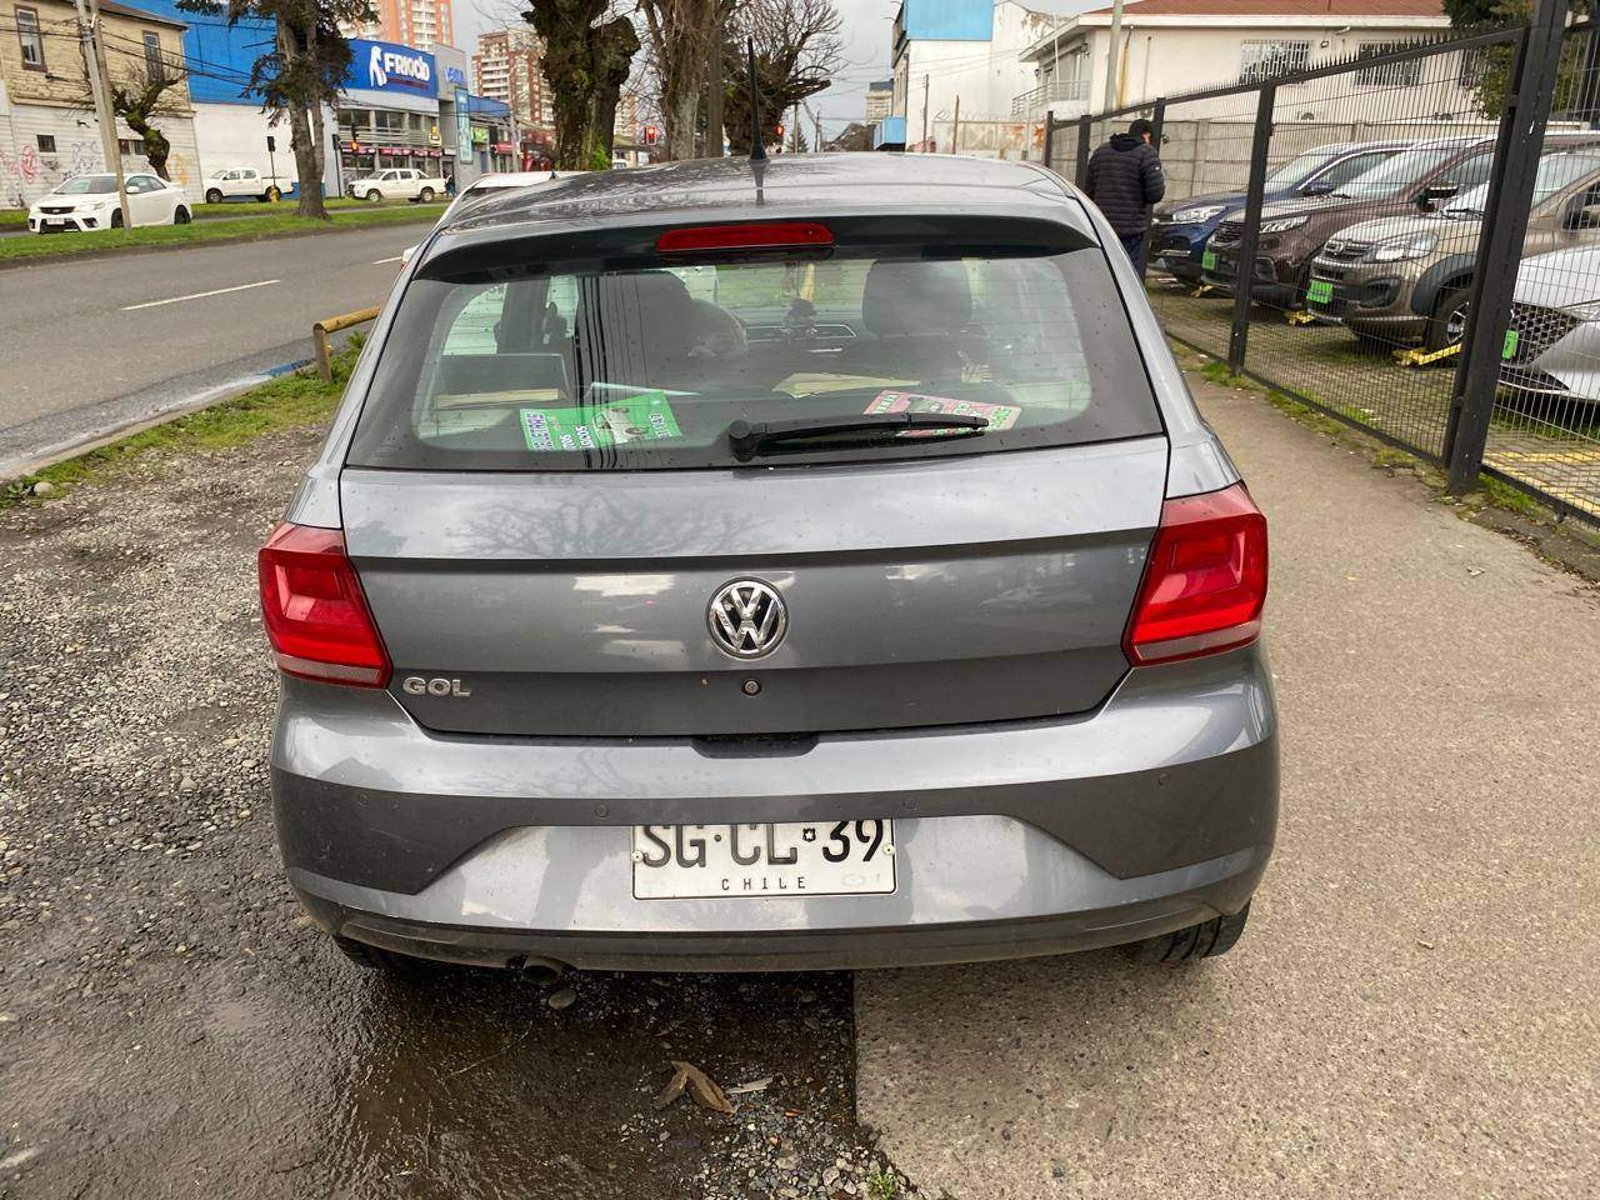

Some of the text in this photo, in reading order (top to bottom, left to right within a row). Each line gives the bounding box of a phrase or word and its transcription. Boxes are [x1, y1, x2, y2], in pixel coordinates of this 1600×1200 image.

[707, 580, 786, 655] VW
[403, 676, 472, 697] GOL
[721, 876, 806, 891] CHILE
